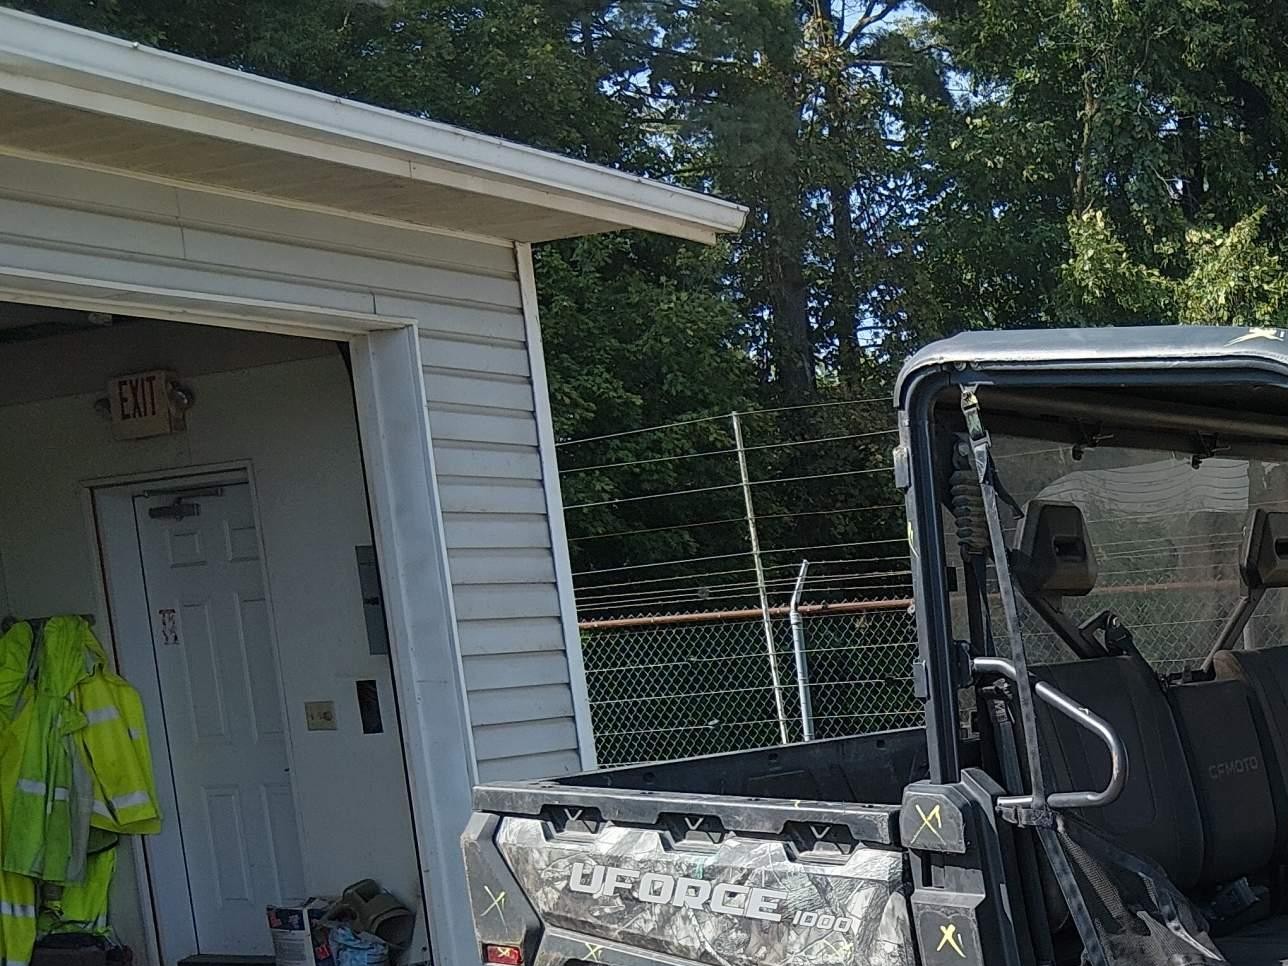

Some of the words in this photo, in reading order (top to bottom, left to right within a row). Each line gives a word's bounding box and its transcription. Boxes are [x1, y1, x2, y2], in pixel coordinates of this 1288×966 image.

[118, 375, 157, 420] EXIT
[1208, 755, 1258, 780] CFMOTO
[569, 862, 788, 922] UFORCE
[792, 910, 853, 933] 1000
